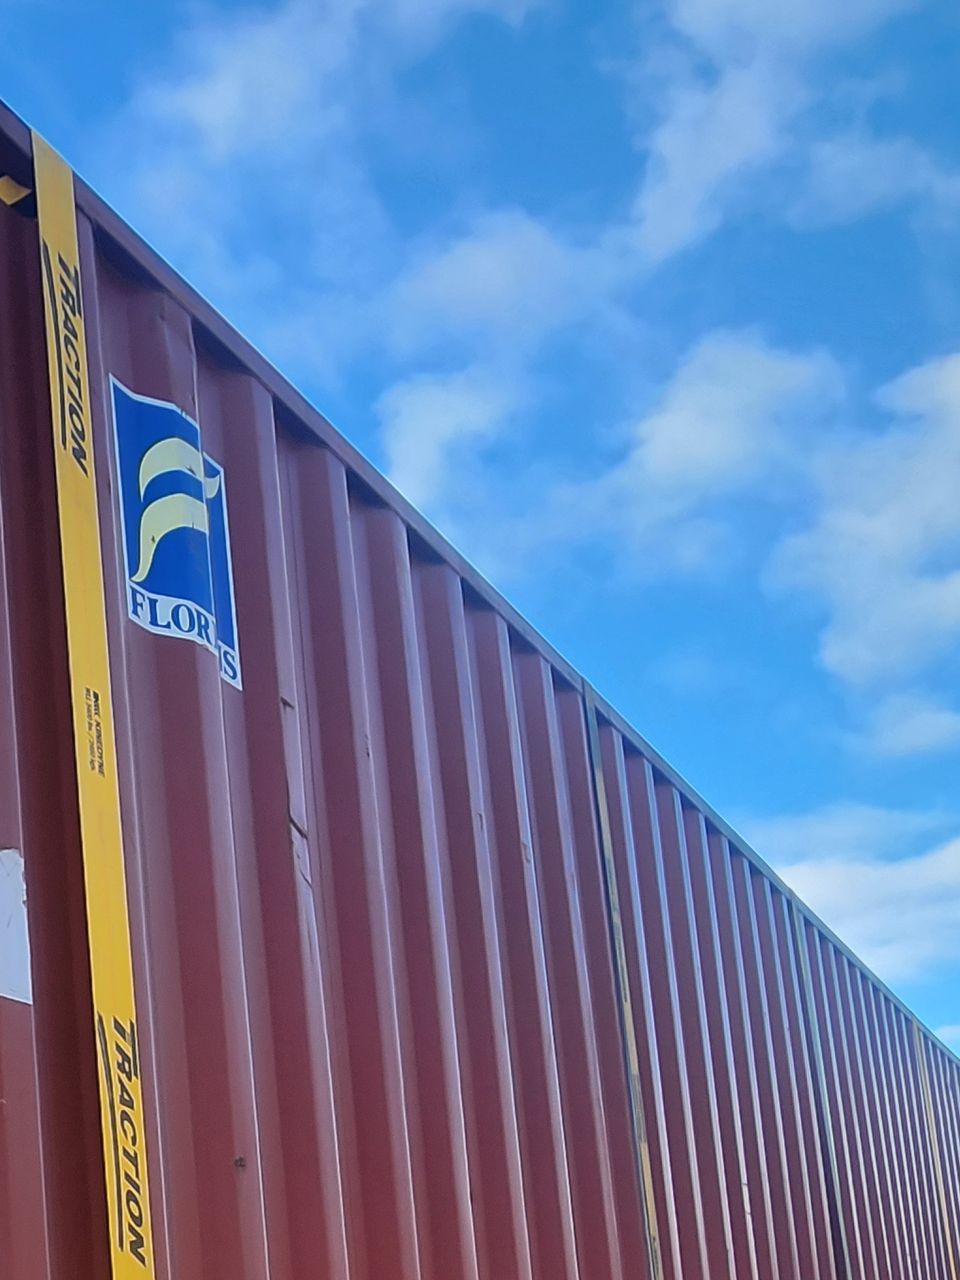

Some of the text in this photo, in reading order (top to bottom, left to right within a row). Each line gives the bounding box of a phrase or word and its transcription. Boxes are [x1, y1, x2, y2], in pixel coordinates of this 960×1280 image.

[57, 250, 89, 479] TRACTION
[129, 585, 238, 681] FLORS
[111, 1016, 147, 1267] TRACTION
